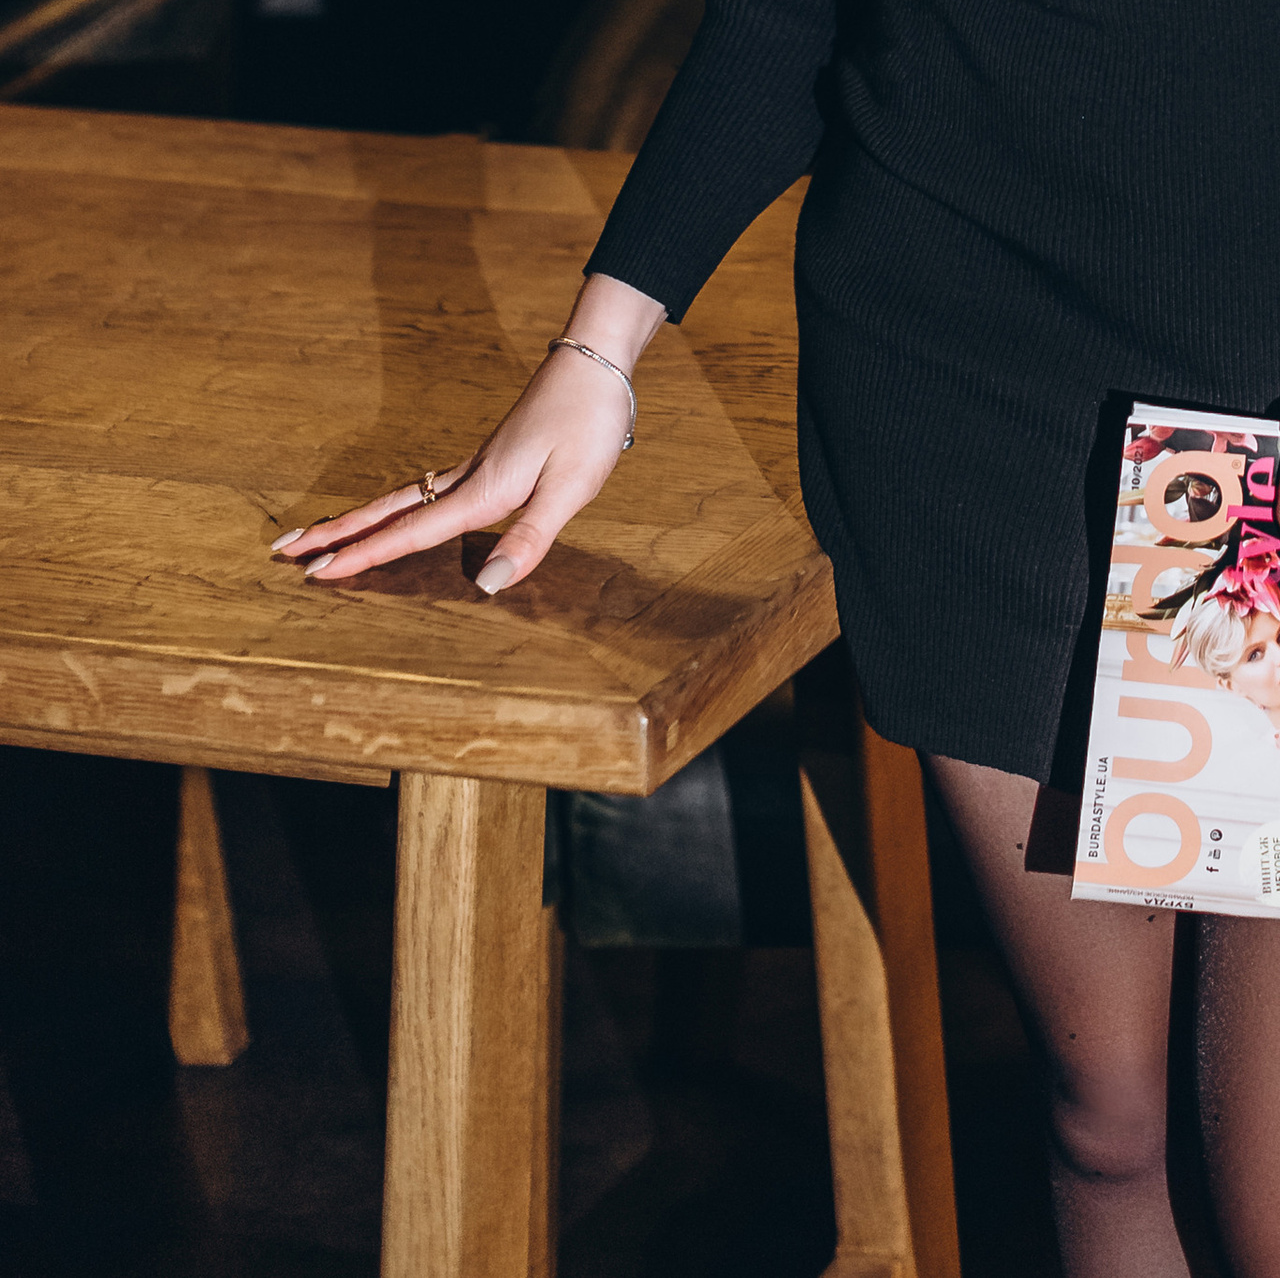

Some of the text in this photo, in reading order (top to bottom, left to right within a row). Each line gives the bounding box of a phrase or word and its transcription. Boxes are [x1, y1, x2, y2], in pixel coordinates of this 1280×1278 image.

[1130, 444, 1146, 490] 10/2021
[1073, 454, 1246, 887] burda
[1087, 755, 1109, 857] BURDASTYLE.UA
[1259, 836, 1271, 893] ВИНТАЖ
[1143, 896, 1193, 908] БУРДА
